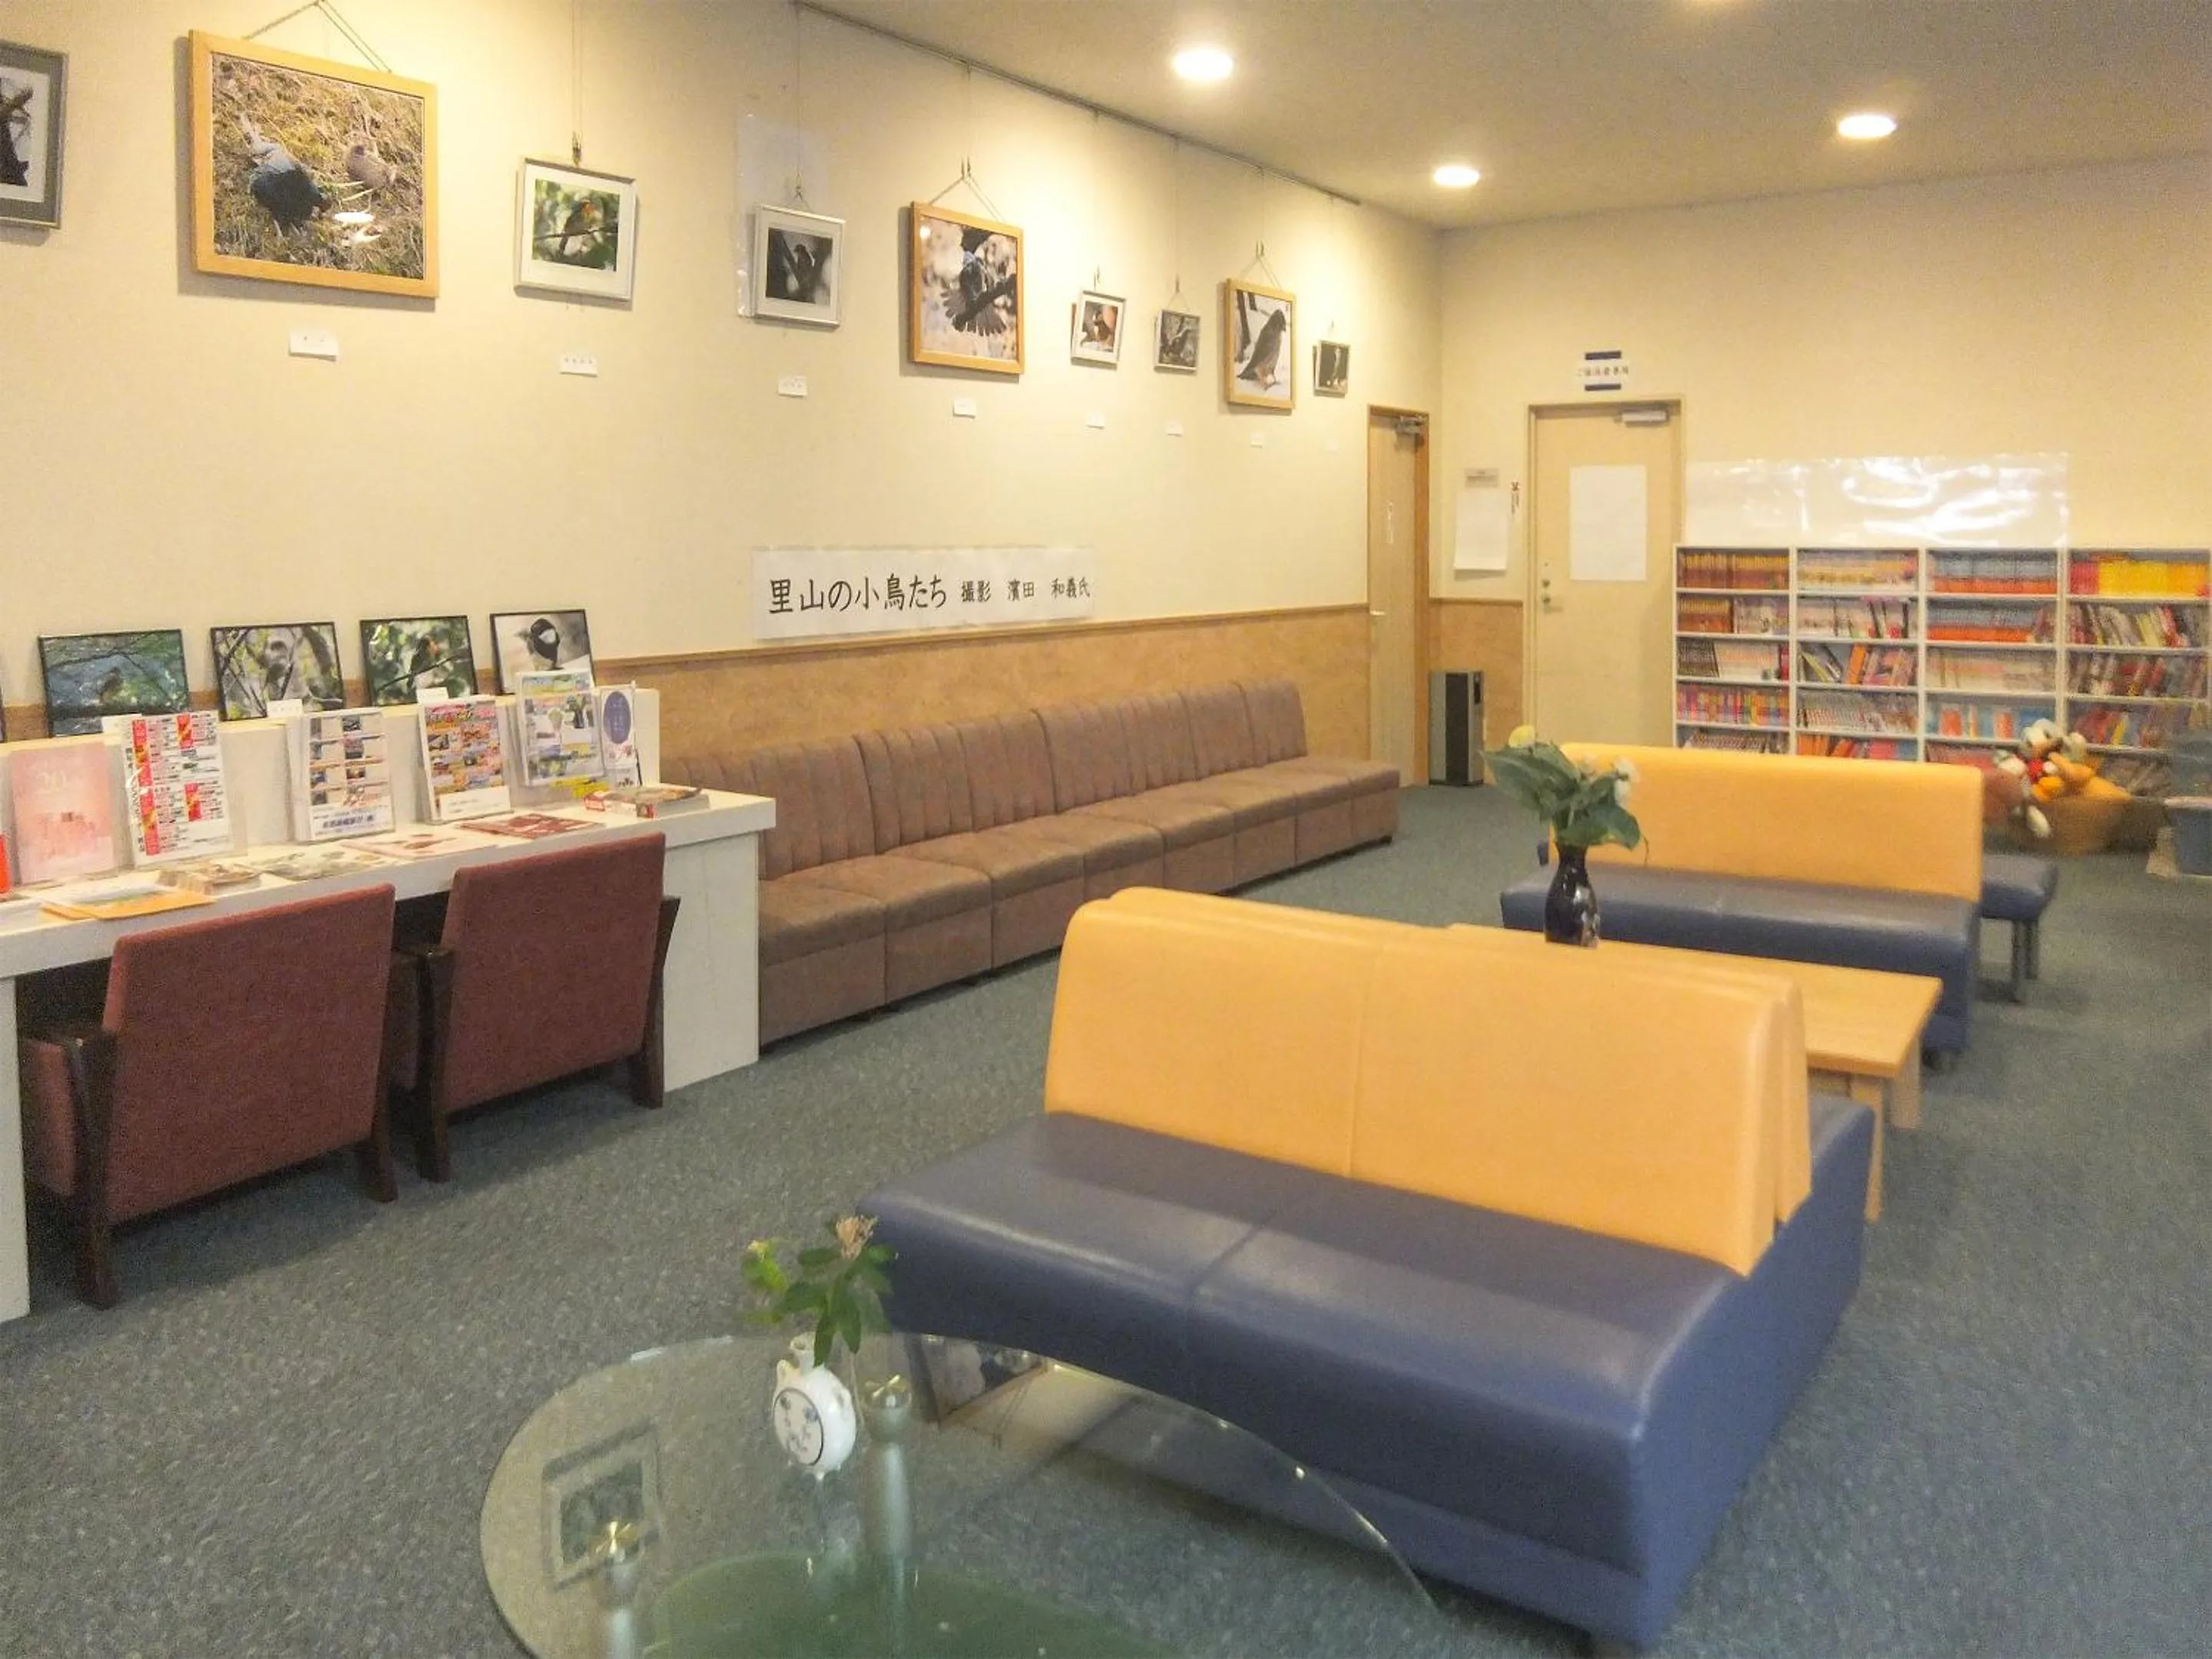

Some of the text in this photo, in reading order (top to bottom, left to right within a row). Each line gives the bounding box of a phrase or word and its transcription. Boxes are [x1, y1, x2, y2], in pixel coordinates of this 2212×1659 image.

[768, 573, 947, 614] 里山の小鳥たち
[960, 580, 992, 603] 撮影
